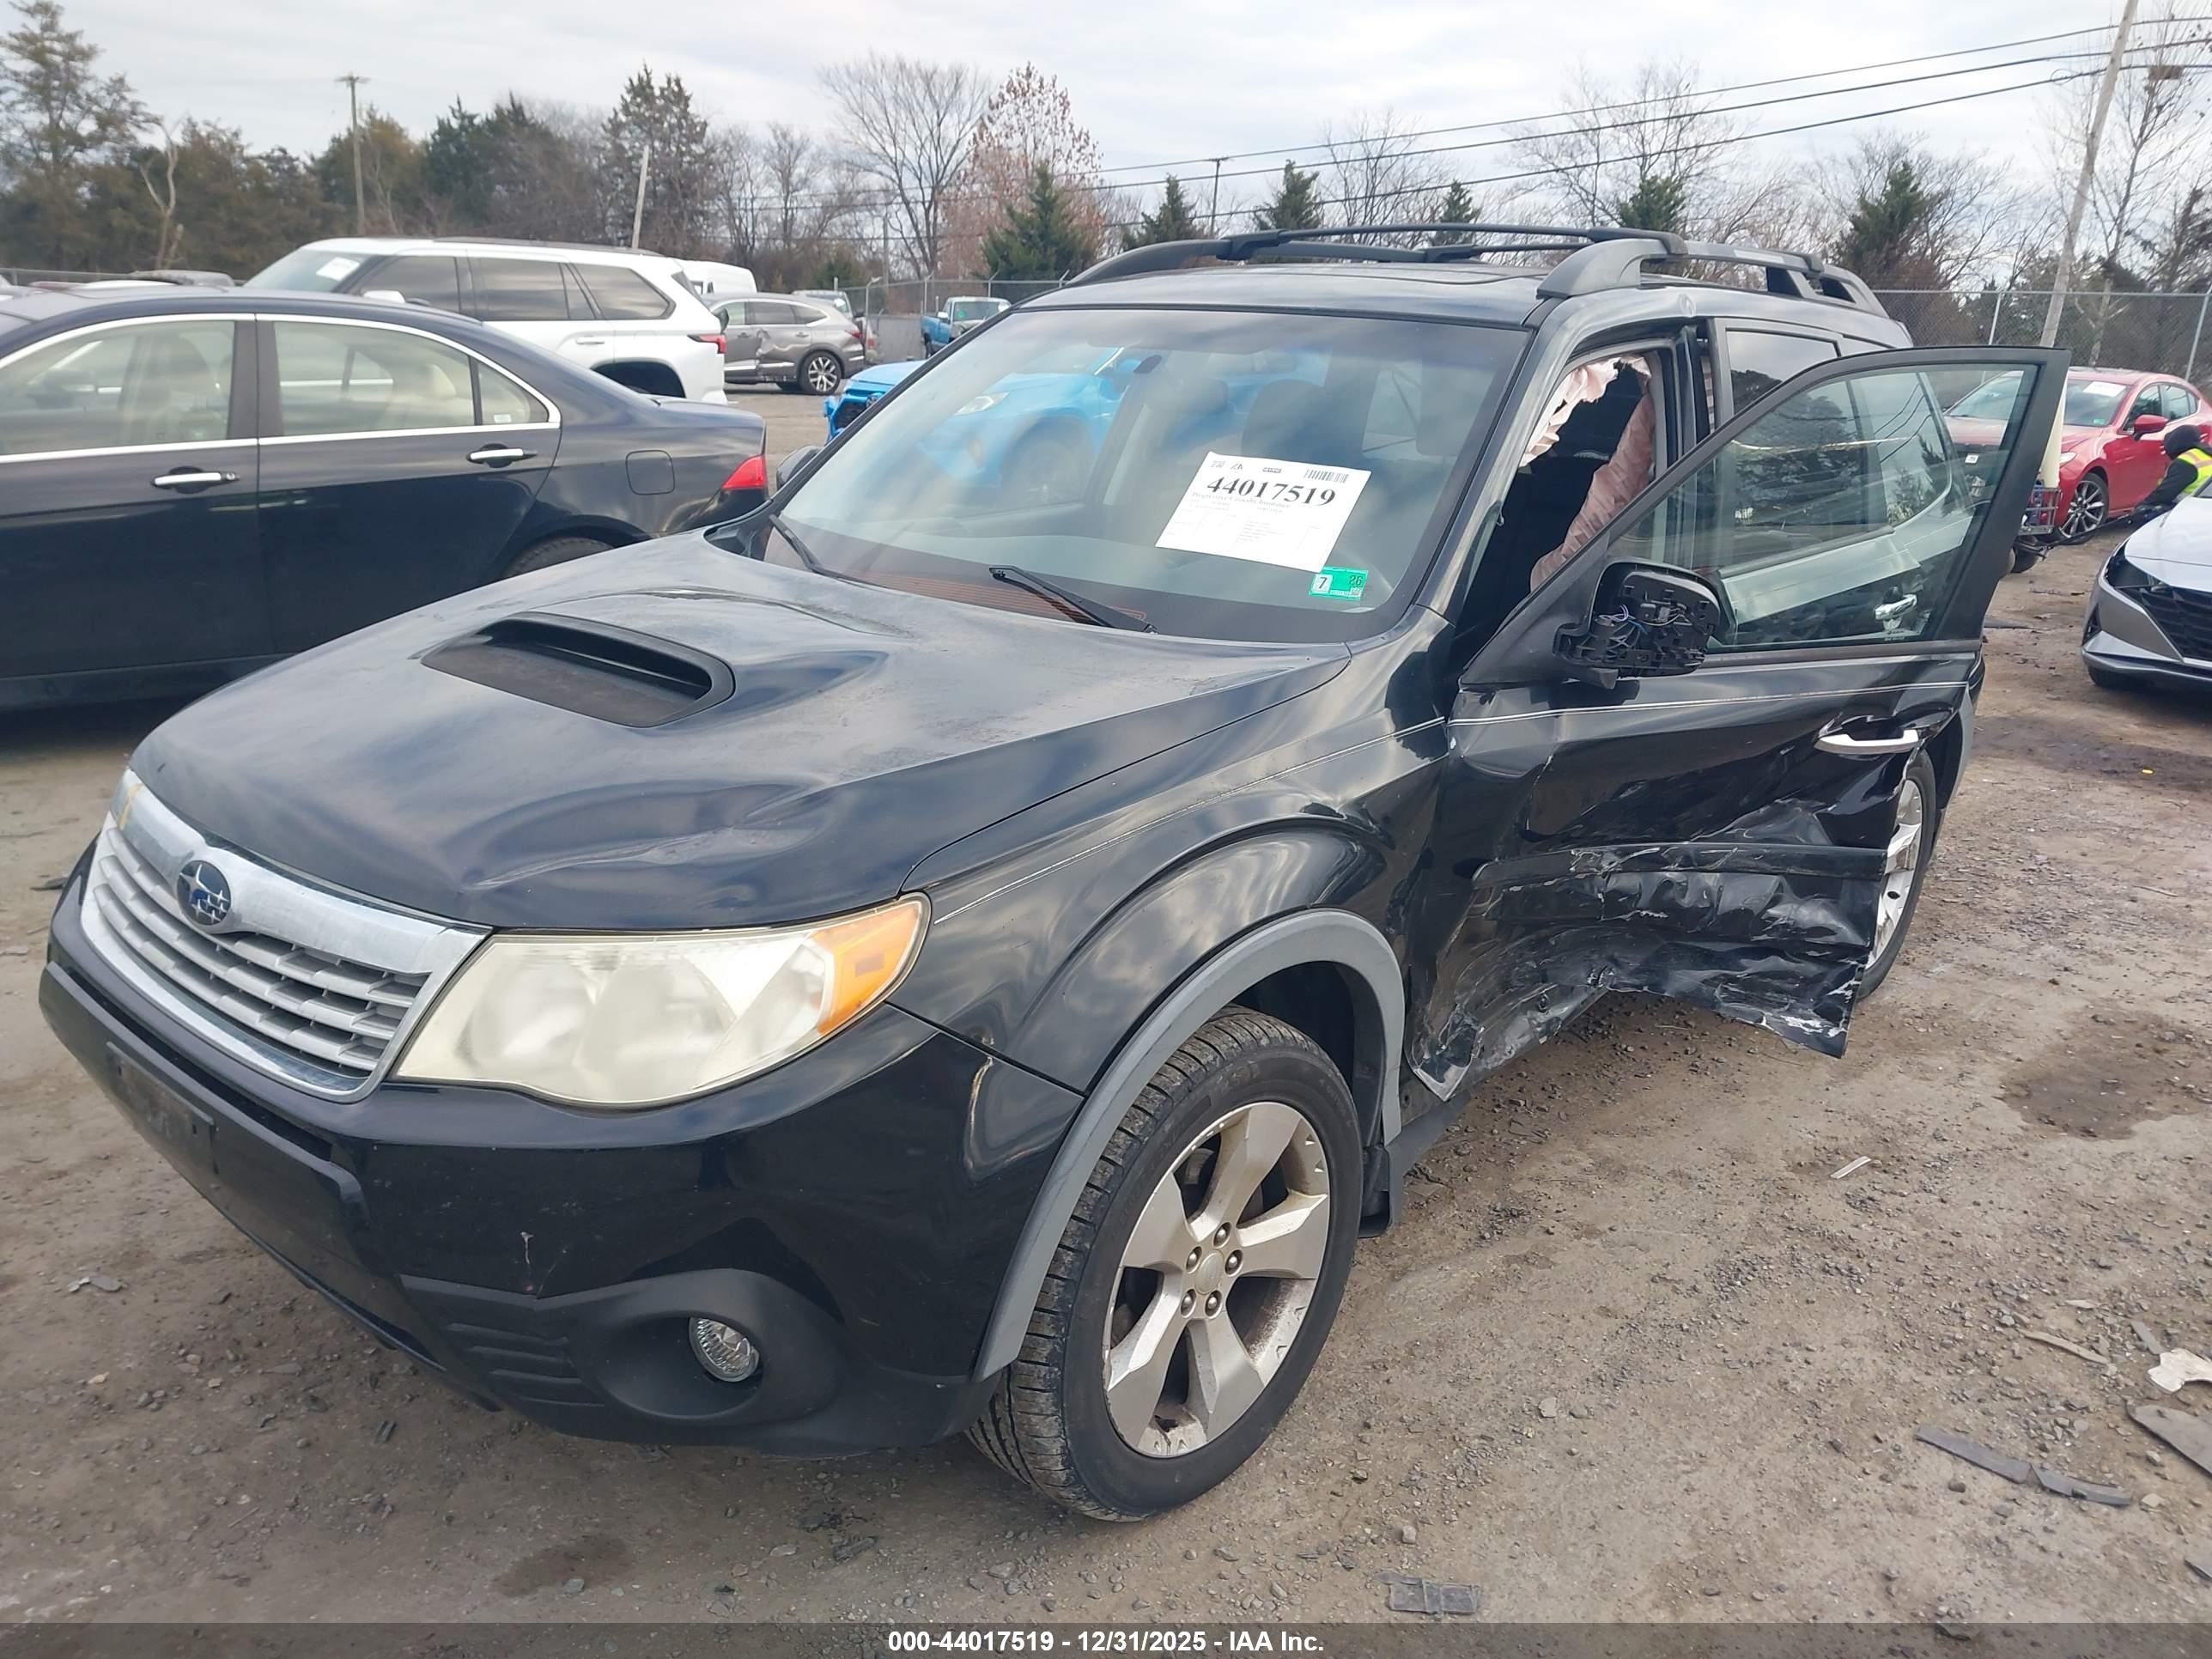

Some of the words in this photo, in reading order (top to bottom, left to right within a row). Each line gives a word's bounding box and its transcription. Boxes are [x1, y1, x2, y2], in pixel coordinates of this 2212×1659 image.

[1206, 476, 1336, 506] 44017519
[1319, 576, 1328, 589] 7
[1349, 575, 1364, 587] 26
